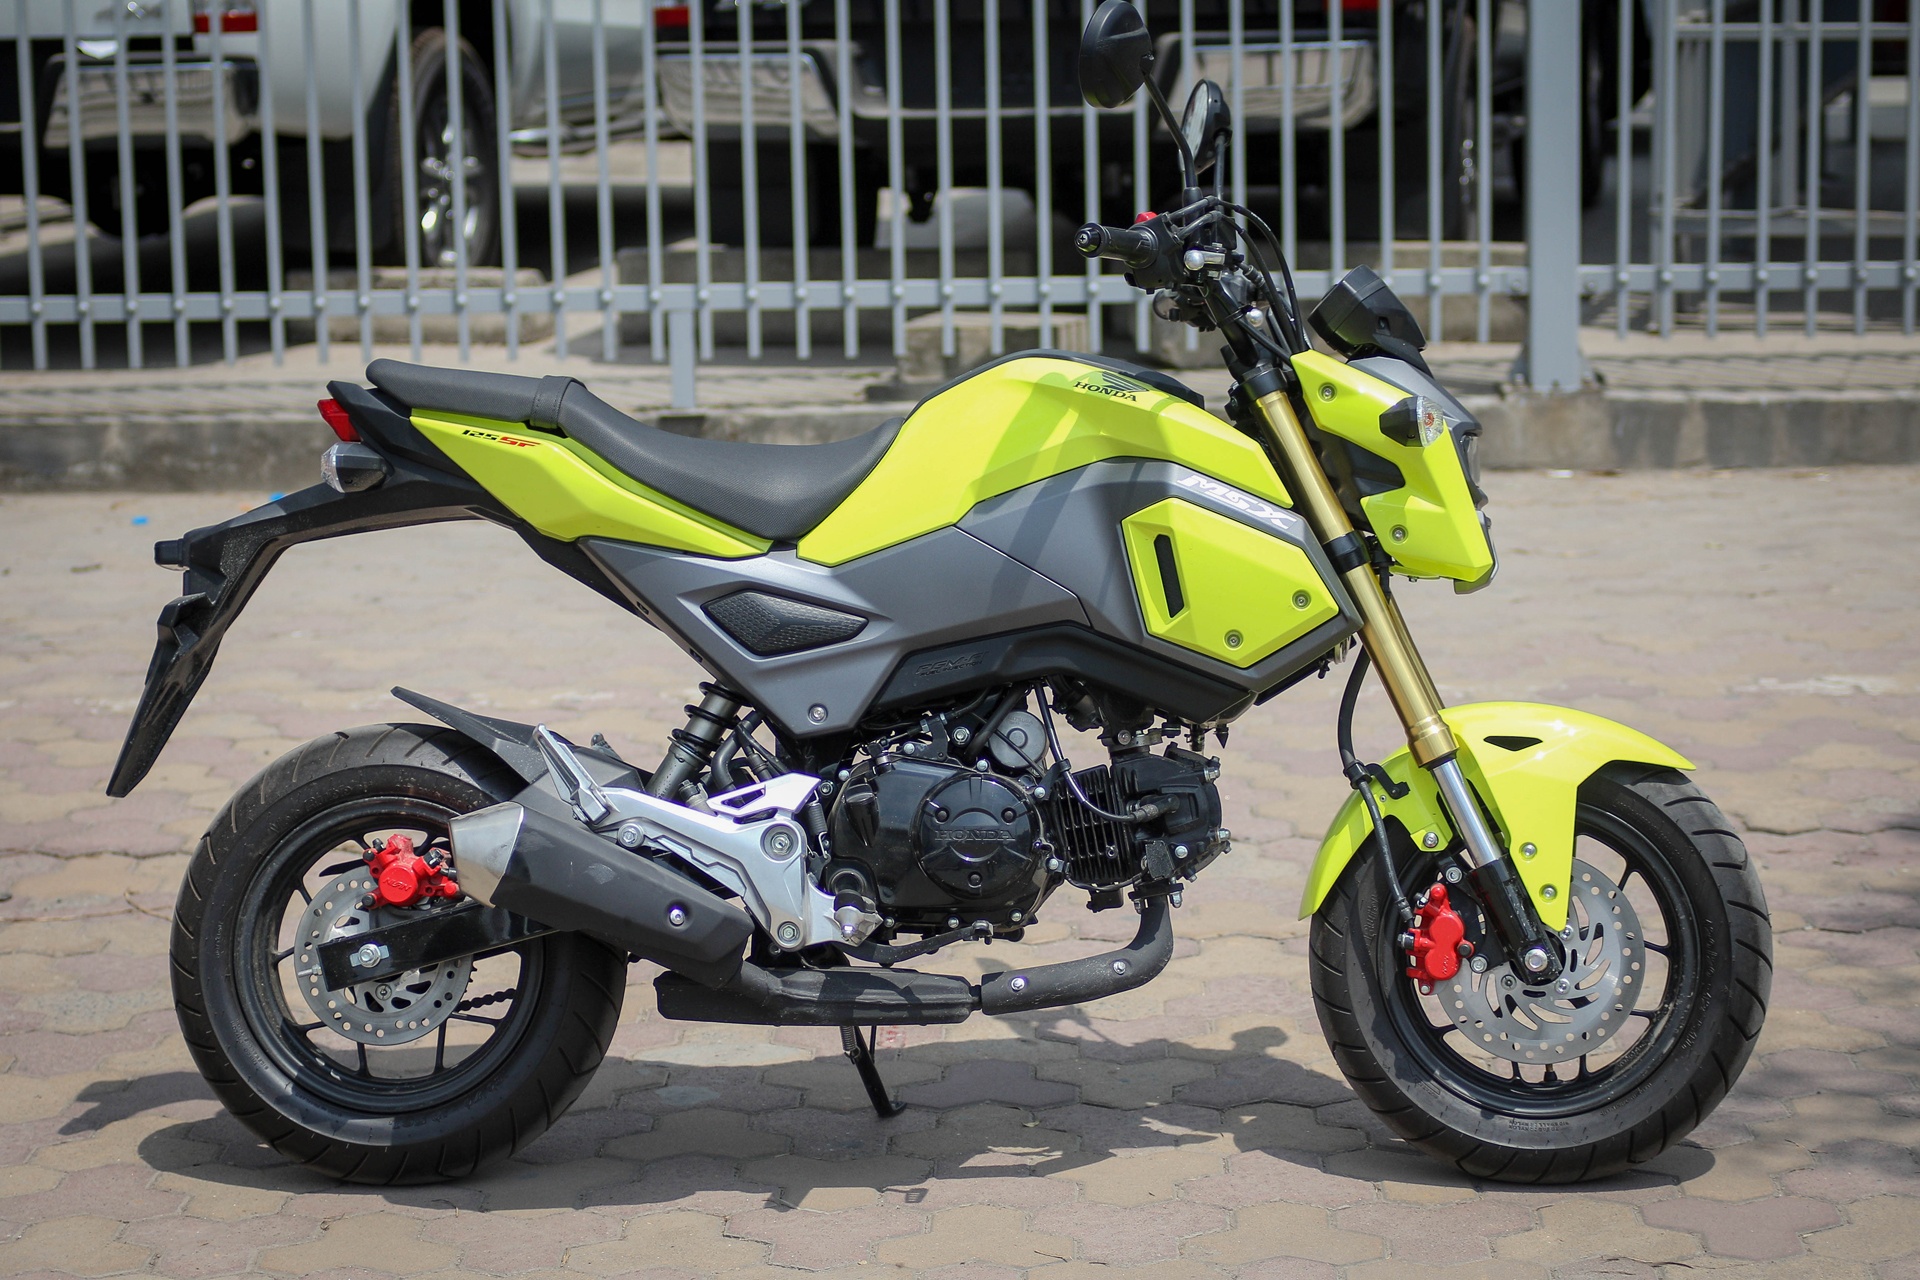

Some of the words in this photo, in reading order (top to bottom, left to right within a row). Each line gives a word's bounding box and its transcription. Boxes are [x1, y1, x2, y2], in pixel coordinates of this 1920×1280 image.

[1073, 381, 1137, 402] HONDA
[1176, 474, 1298, 530] MSX
[934, 829, 1016, 841] HONDA
